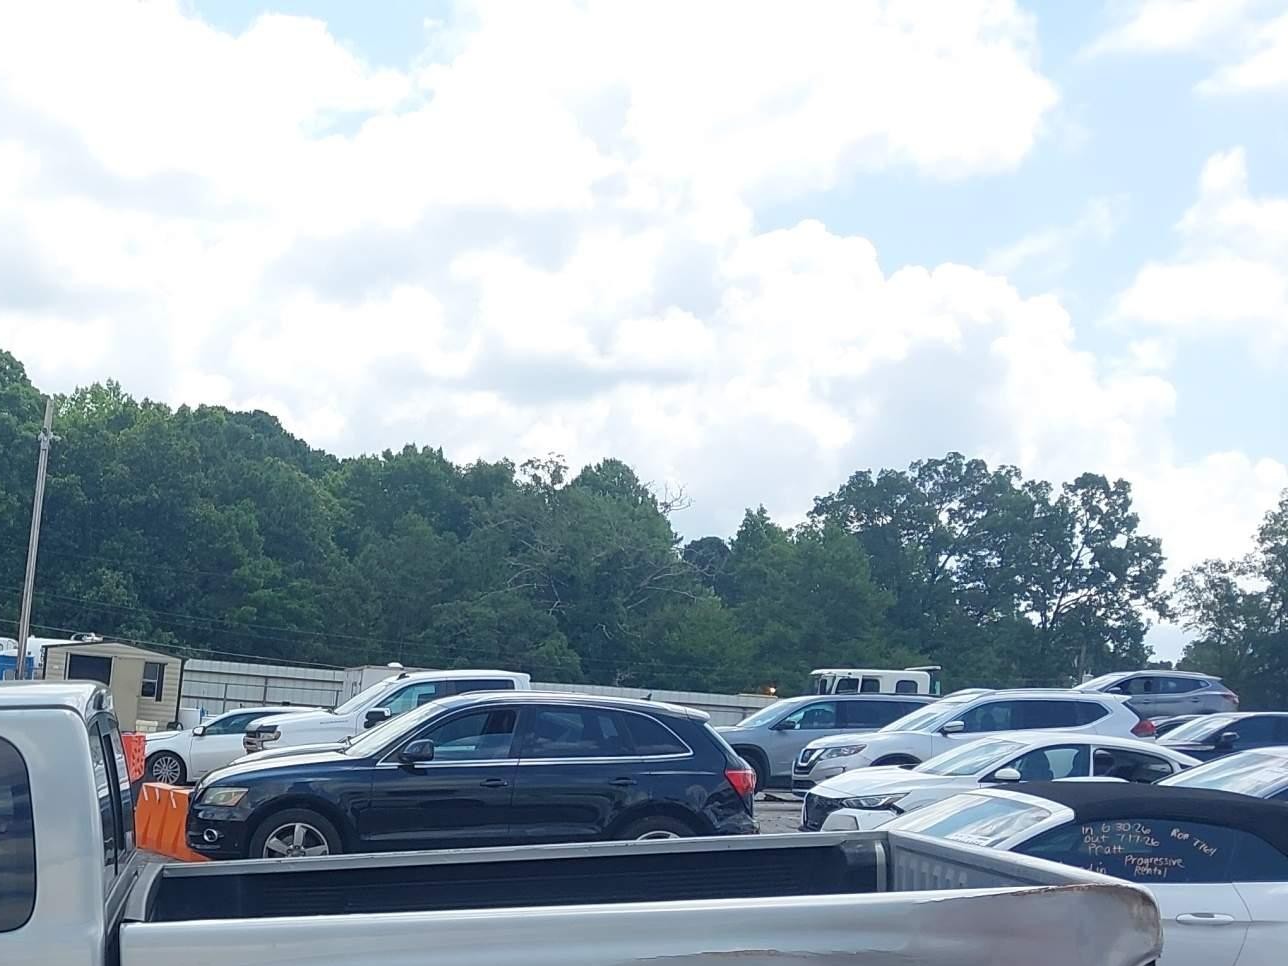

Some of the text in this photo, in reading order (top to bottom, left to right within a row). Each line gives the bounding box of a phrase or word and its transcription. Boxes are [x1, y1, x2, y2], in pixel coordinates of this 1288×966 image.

[1088, 844, 1125, 856] Pratt
[1125, 855, 1185, 868] Progressive
[1133, 866, 1168, 878] Rental
